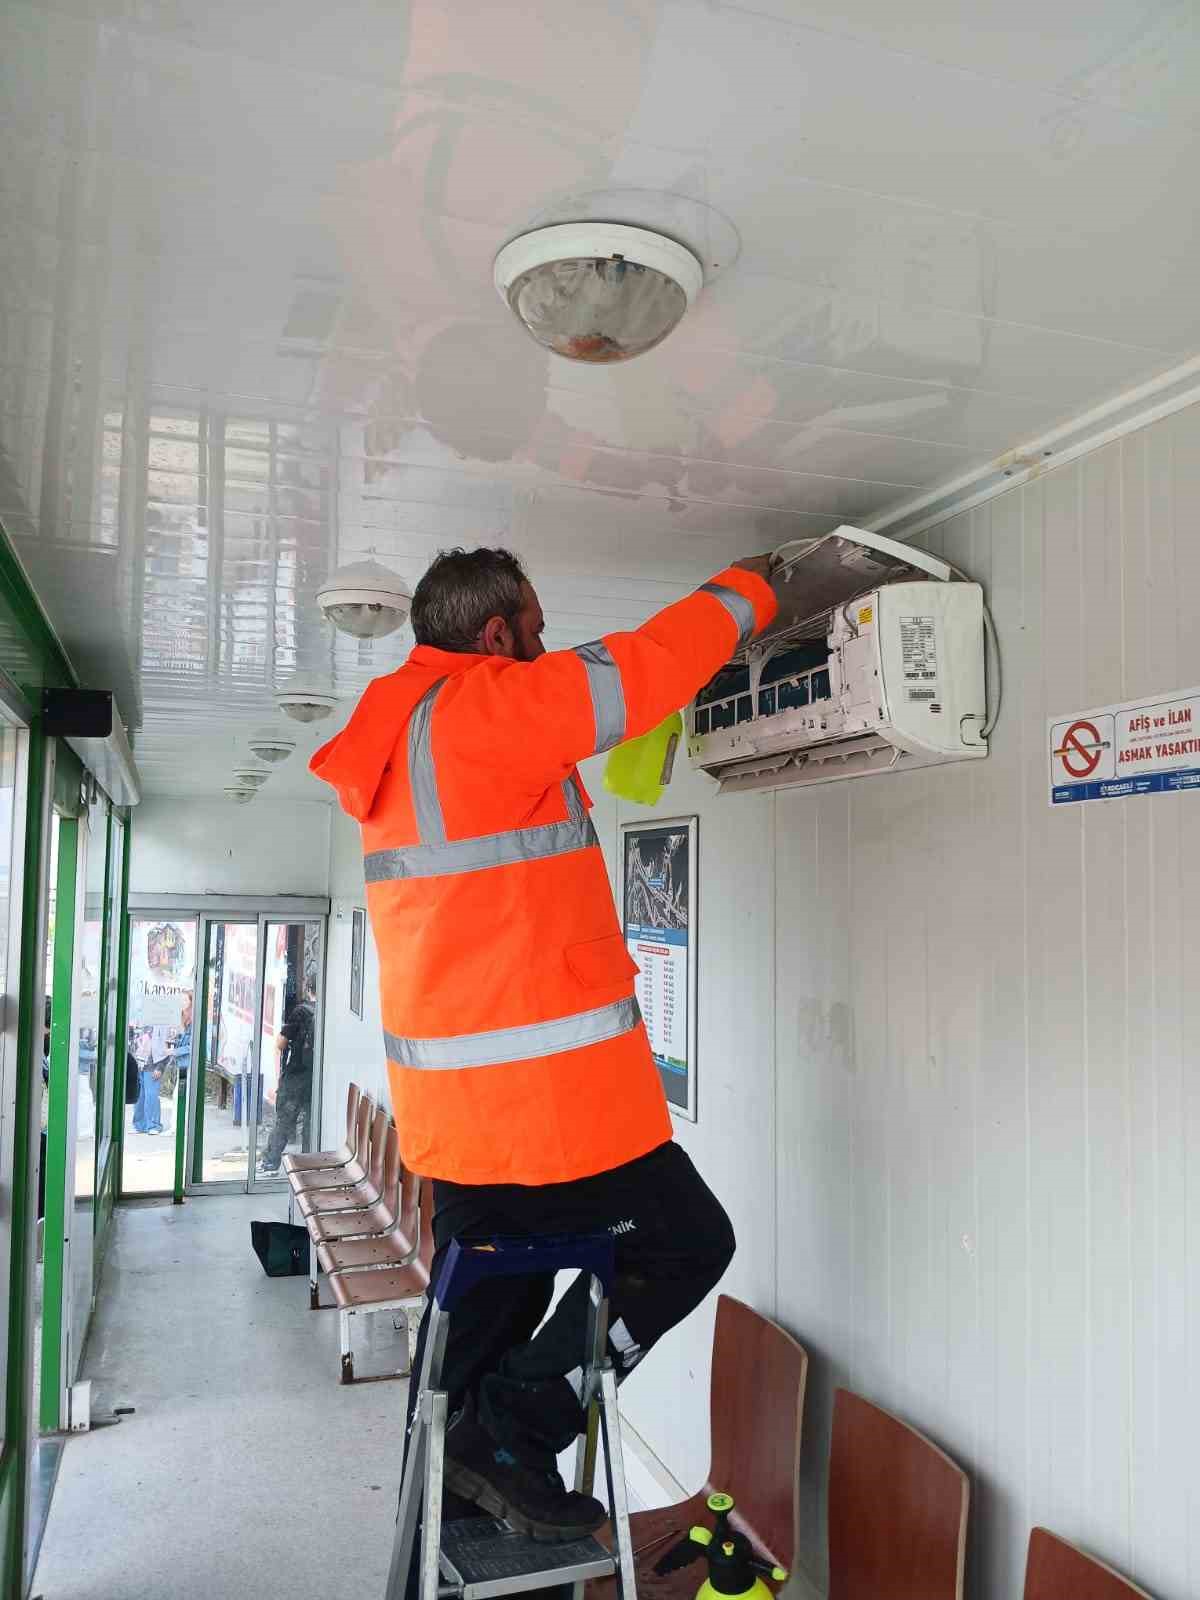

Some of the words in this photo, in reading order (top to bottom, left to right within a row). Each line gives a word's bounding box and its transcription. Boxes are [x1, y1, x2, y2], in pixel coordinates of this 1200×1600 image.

[1129, 714, 1151, 733] AFİŞ
[1153, 717, 1165, 728] ve
[1168, 708, 1192, 725] İLAN
[1119, 746, 1152, 763] ASMAK
[608, 1219, 637, 1235] NİK
